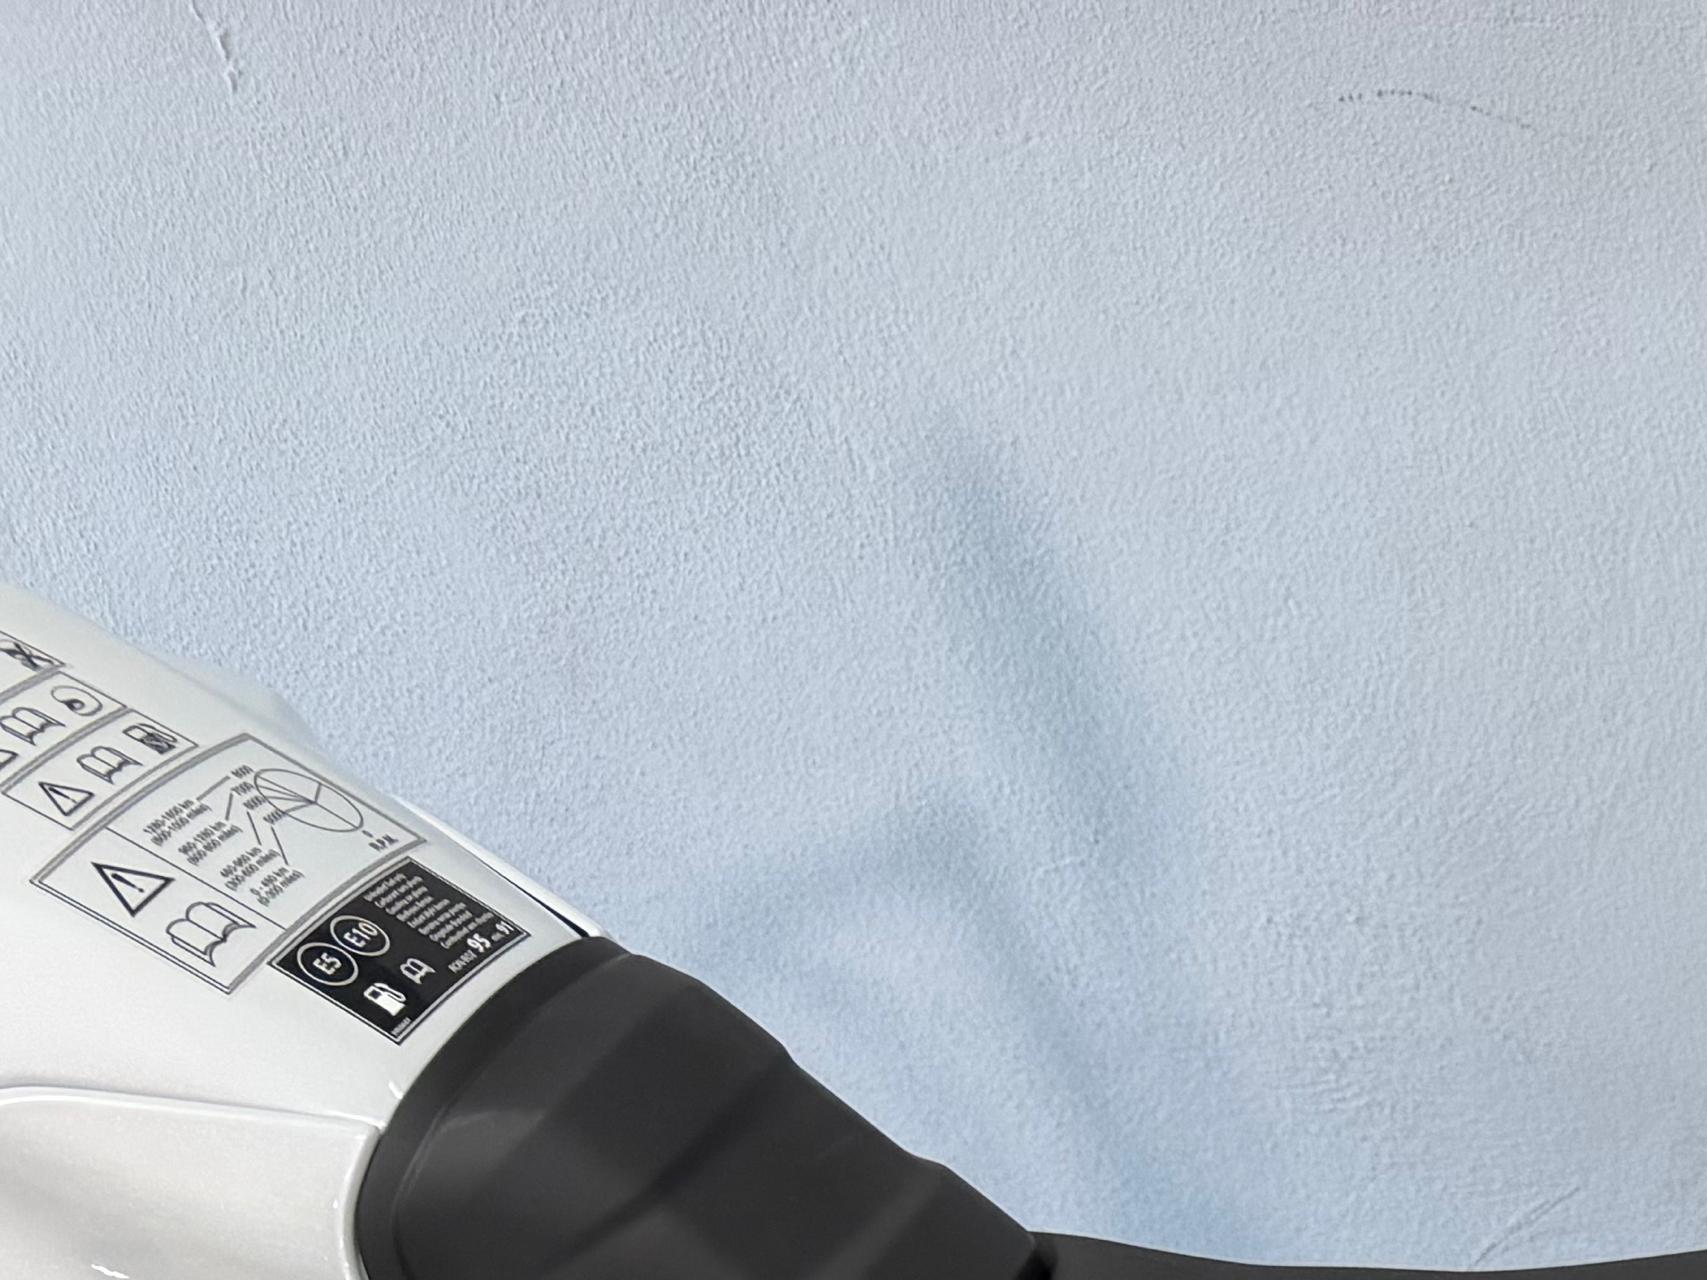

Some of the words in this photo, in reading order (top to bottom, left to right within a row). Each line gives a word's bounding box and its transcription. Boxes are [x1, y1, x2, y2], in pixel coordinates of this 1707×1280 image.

[343, 922, 378, 948] E10
[467, 932, 491, 953] 95
[312, 952, 342, 976] E5
